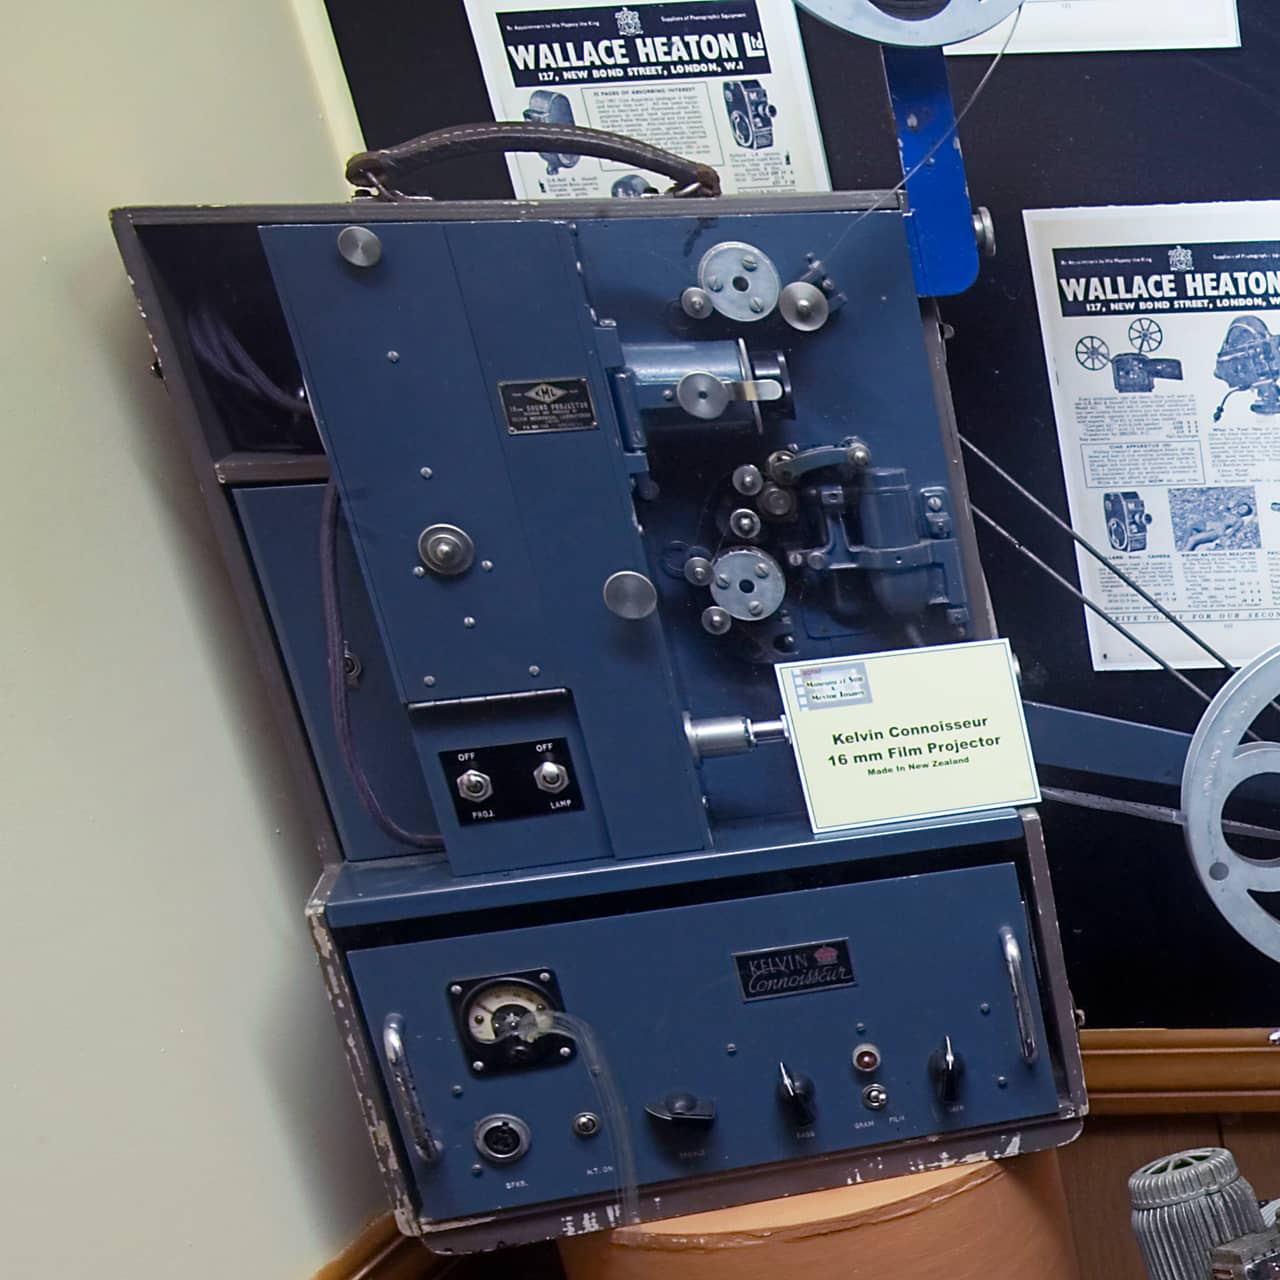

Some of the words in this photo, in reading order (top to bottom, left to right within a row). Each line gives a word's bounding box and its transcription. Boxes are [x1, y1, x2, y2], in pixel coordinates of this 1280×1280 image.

[508, 39, 630, 71] WALLACE
[636, 33, 738, 64] HEATON
[538, 72, 559, 81] 127,
[563, 70, 587, 80] NEW
[592, 67, 623, 79] BOND
[628, 65, 668, 77] STREET,
[671, 62, 721, 74] LONDON,
[1060, 275, 1176, 301] WALLACE
[832, 729, 883, 745] Kelvin
[889, 717, 988, 738] Connoisseur
[458, 752, 475, 761] OFF
[536, 743, 552, 752] OFF
[828, 754, 848, 767] 16
[854, 751, 882, 764] mm
[888, 746, 922, 760] Film
[928, 736, 1000, 755] Projector
[868, 767, 893, 776] Made
[897, 764, 905, 772] In
[909, 762, 929, 771] New
[933, 757, 969, 768] Zealand
[550, 800, 571, 809] LAMP
